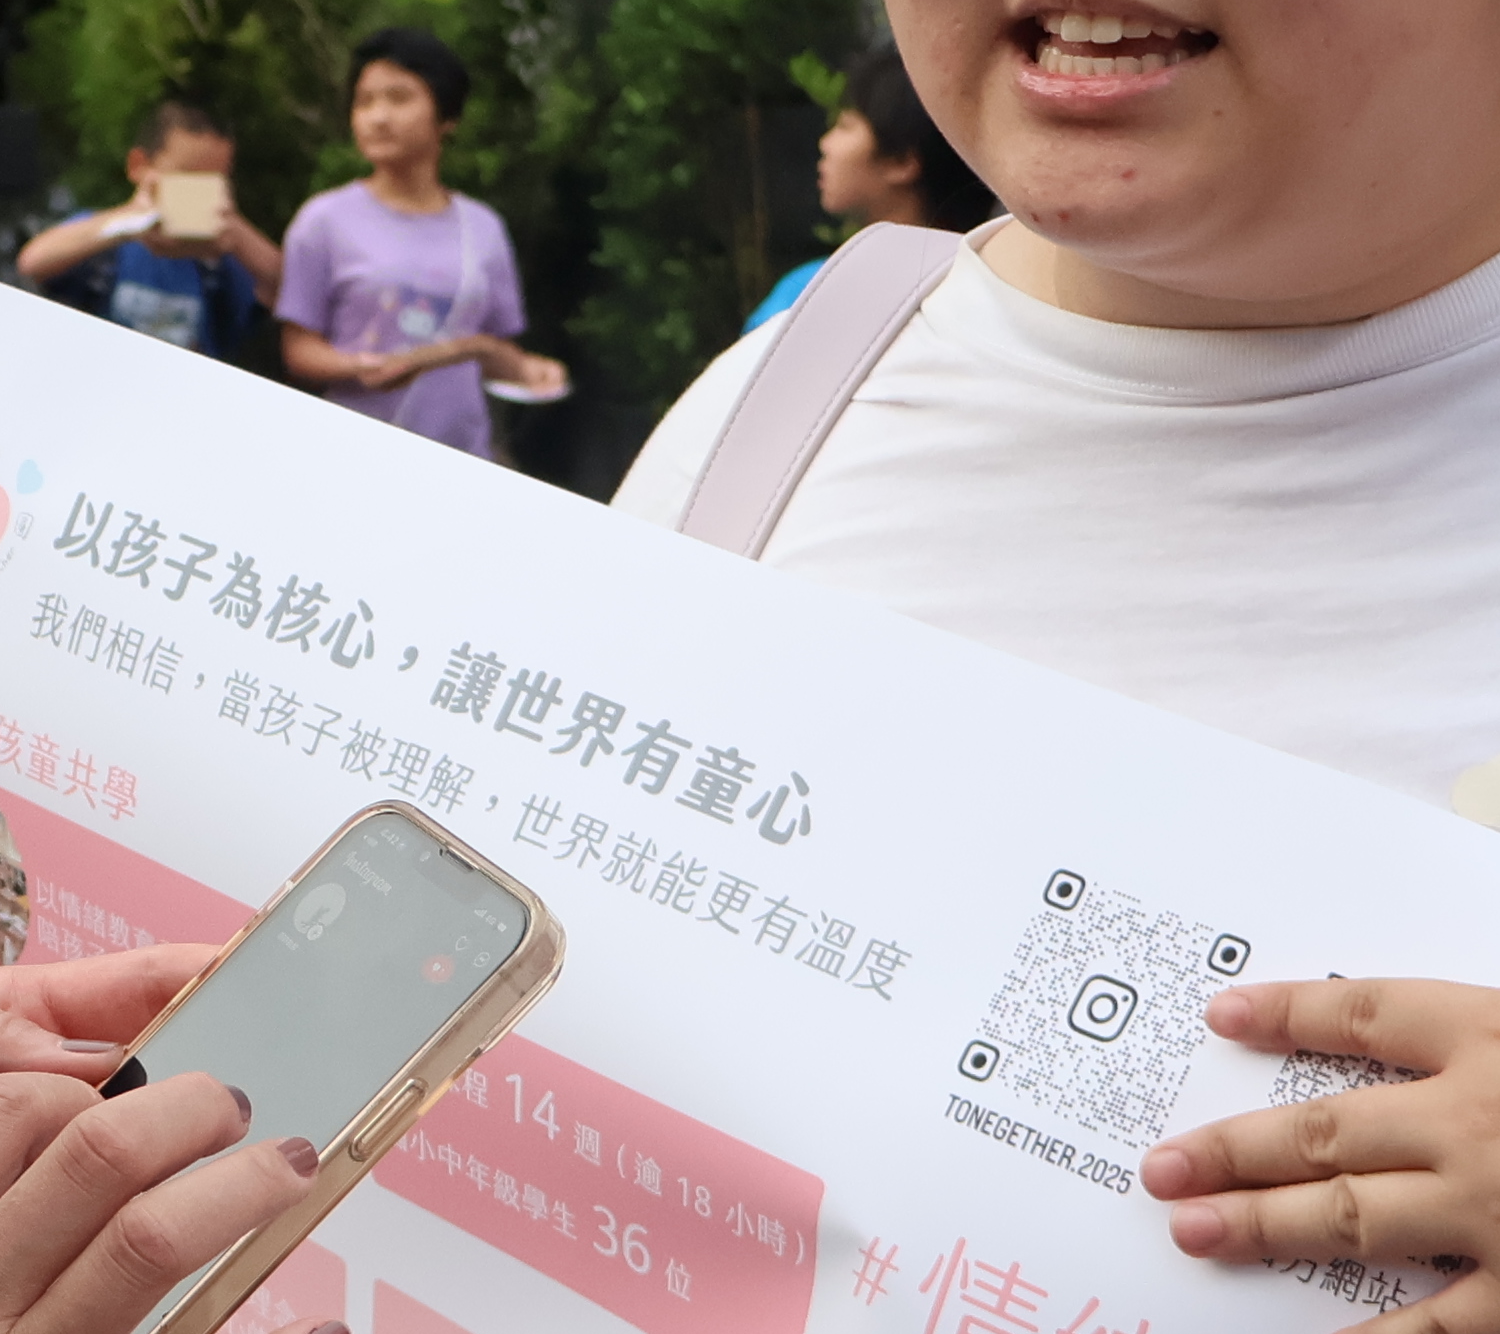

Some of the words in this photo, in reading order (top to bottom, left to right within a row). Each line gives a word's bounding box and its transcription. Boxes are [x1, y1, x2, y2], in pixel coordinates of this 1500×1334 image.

[53, 491, 815, 845] 以孩子為核心，讓世界有童心
[342, 851, 393, 897] Instagram
[392, 1129, 579, 1241] 小中年級學生
[592, 1204, 653, 1276] 36
[664, 1257, 692, 1302] 位
[505, 1073, 561, 1141] 14
[676, 1176, 711, 1219] 18
[942, 1092, 1135, 1197] TONEGETHER.2025
